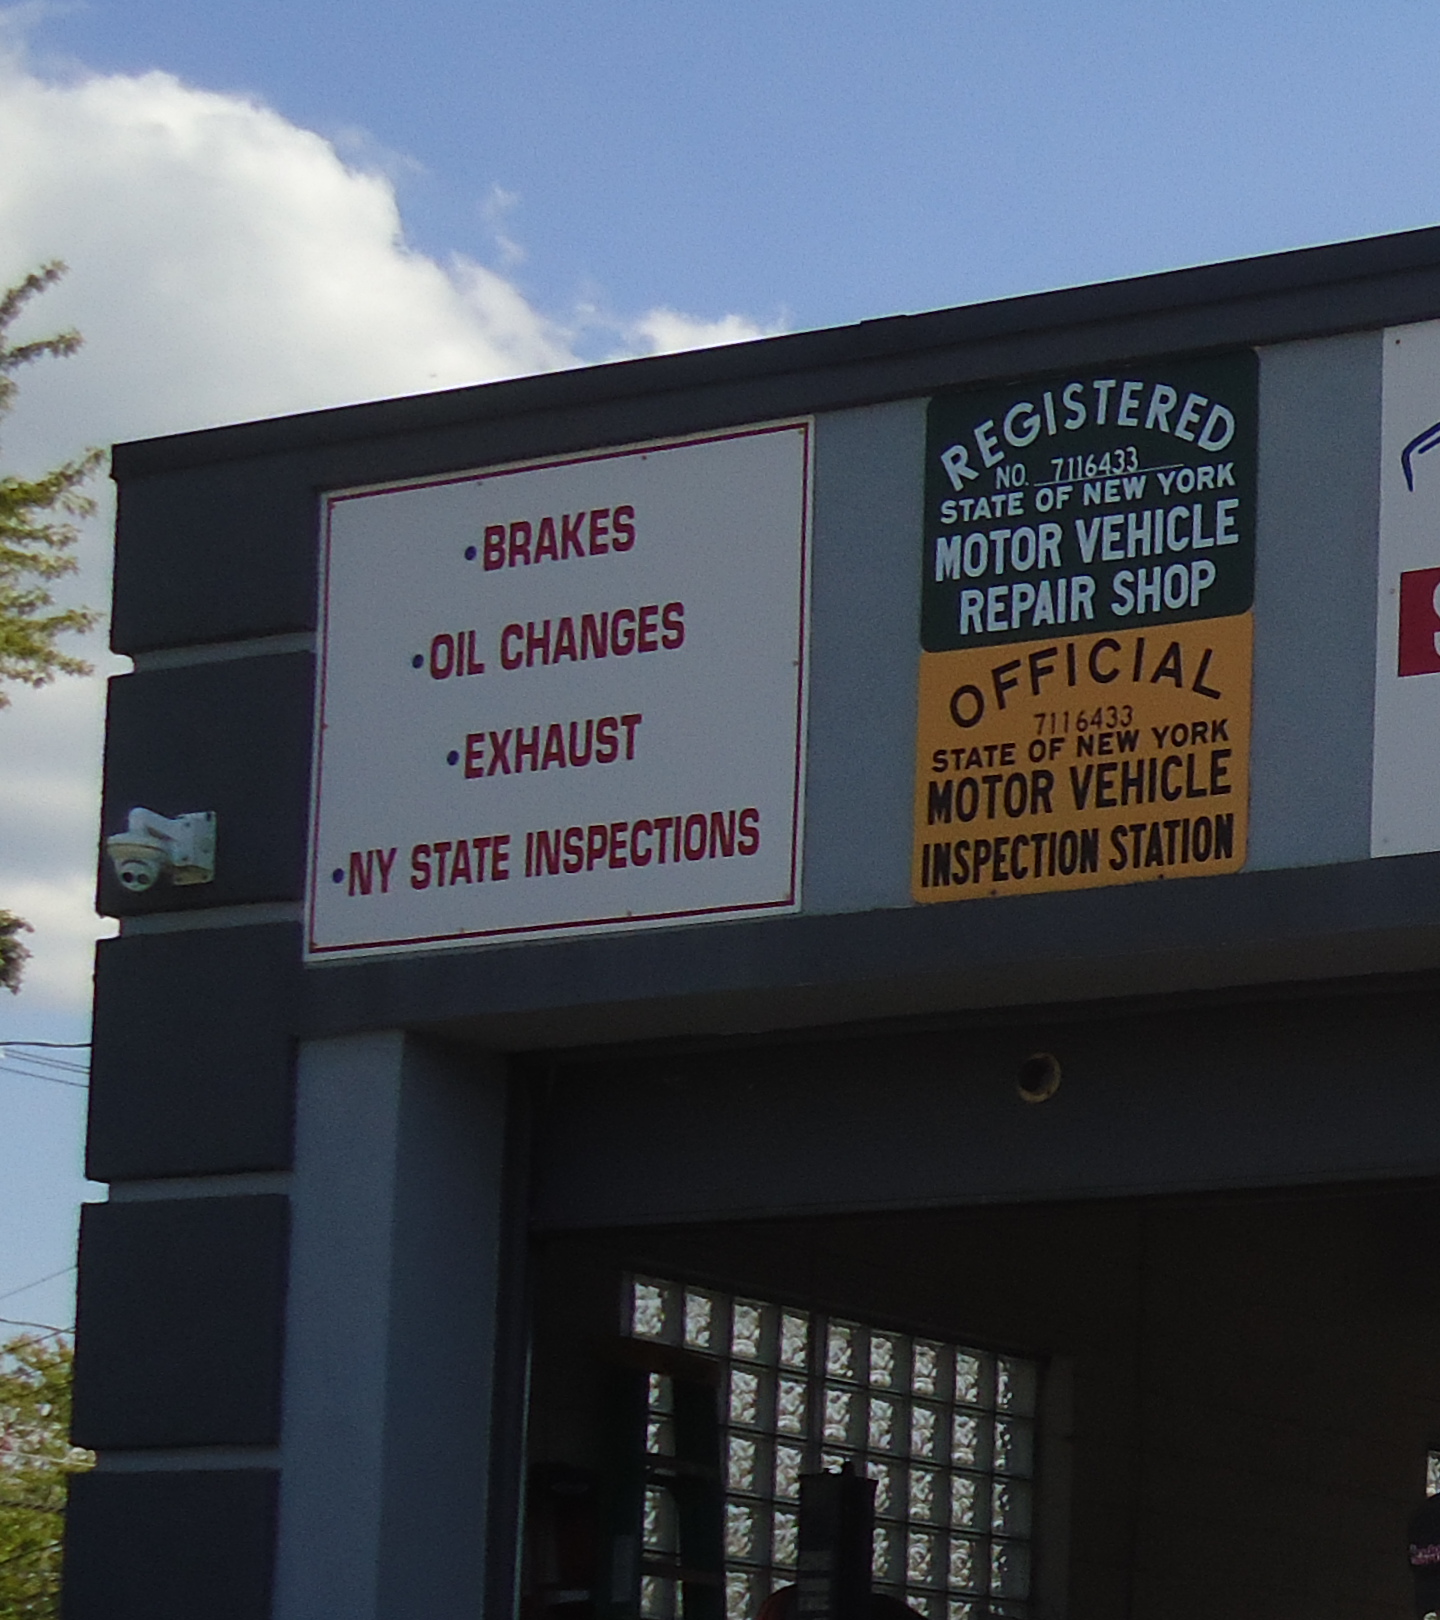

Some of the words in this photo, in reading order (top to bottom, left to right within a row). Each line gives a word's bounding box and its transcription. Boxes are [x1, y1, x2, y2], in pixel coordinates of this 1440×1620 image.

[940, 379, 1235, 492] REGISTERED
[1050, 446, 1139, 482] 7116433
[940, 492, 1024, 524] STATE
[1035, 484, 1070, 512] OF
[1083, 476, 1146, 507] NEW
[1160, 462, 1235, 495] YORK
[482, 505, 636, 571] BRAKES
[934, 522, 1062, 582] MOTOR
[1075, 498, 1239, 564] VEHICLE
[959, 575, 1095, 636] REPAIR
[1111, 560, 1216, 616] SHOP
[429, 630, 485, 681] OIL
[500, 601, 686, 671] CHANGES
[949, 637, 1222, 729] OFFICIAL
[1034, 705, 1134, 735] 7116433
[463, 713, 642, 780] EXHAUST
[931, 742, 1016, 772] STATE
[1028, 736, 1064, 762] OF
[1076, 729, 1140, 757] NEW
[1152, 719, 1230, 747] YORK
[927, 768, 1055, 826] MOTOR
[1069, 748, 1233, 810] VEHICLE
[347, 848, 397, 897] NY
[410, 834, 511, 890] STATE
[524, 807, 760, 878] INSPECTIONS
[921, 827, 1099, 888] INSPECTION
[1109, 812, 1234, 870] STATION
